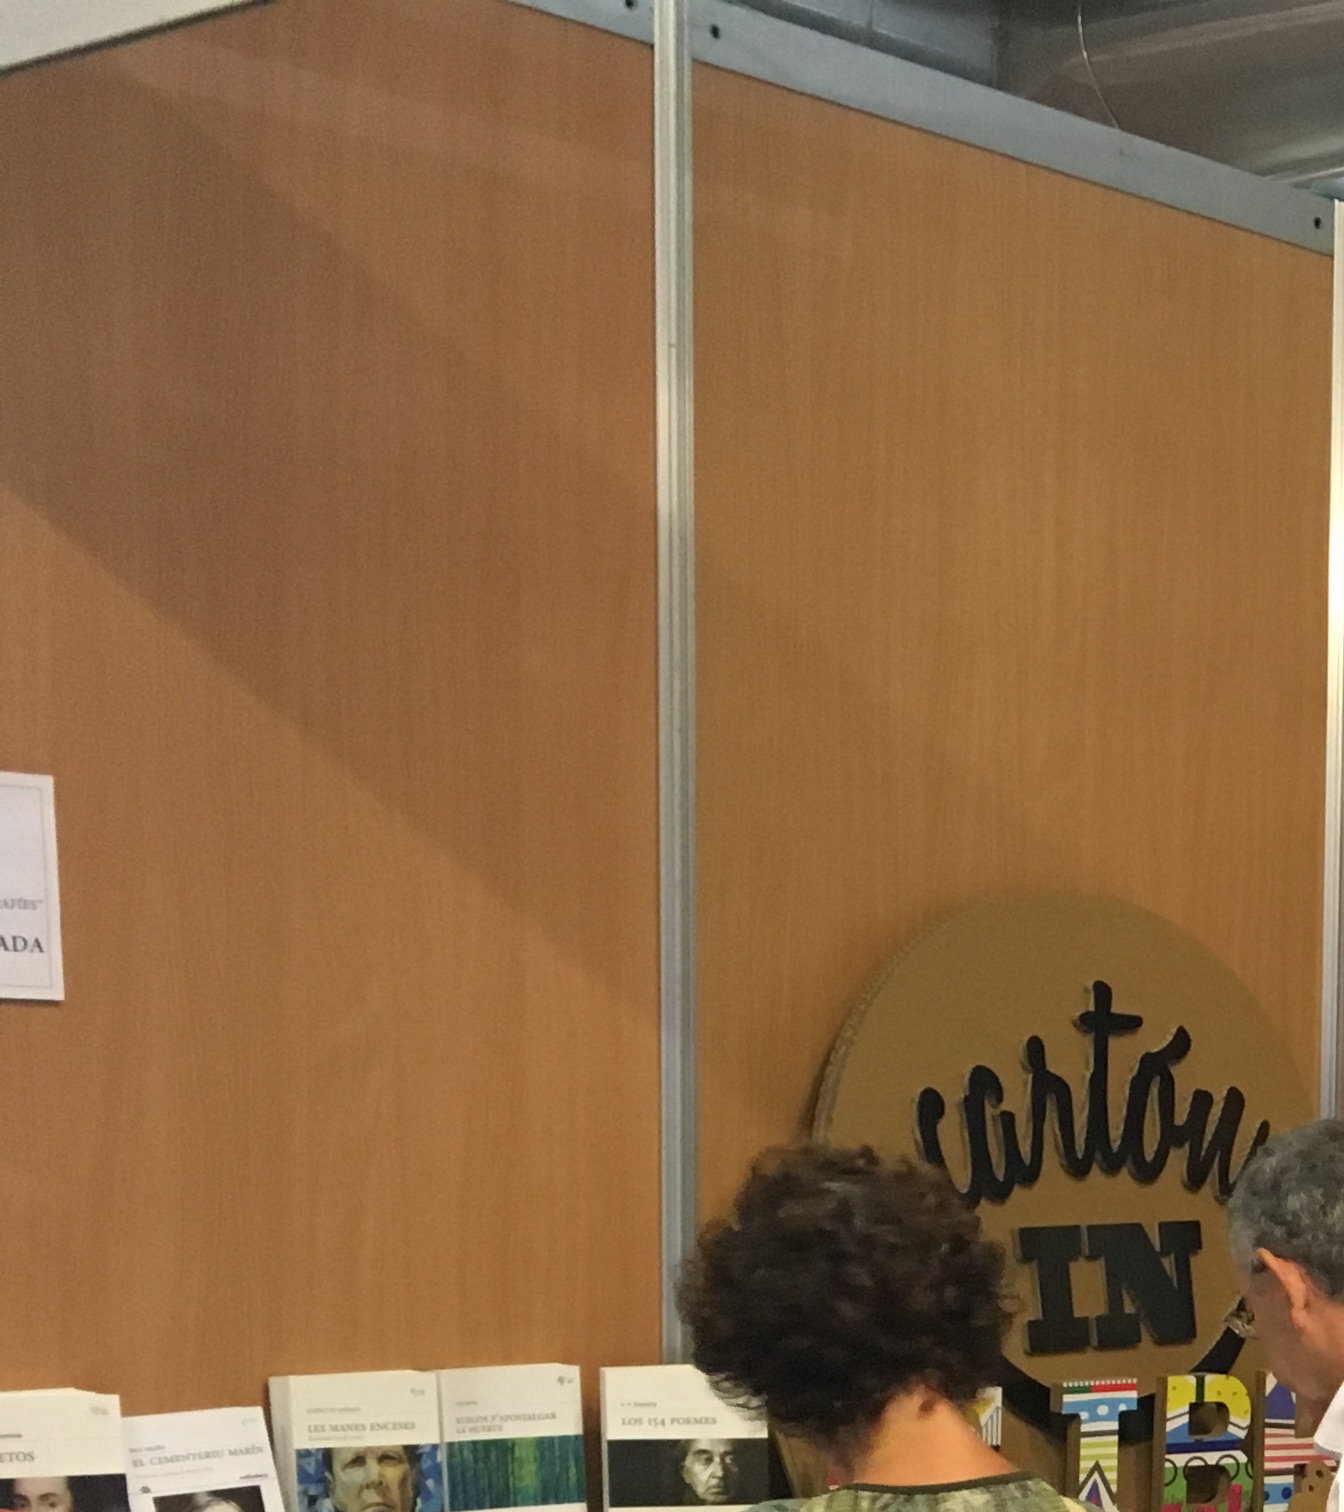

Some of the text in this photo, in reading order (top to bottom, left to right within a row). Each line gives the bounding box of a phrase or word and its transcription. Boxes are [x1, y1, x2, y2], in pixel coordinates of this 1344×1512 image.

[1015, 1219, 1204, 1355] IN
[621, 1416, 643, 1427] LOS
[669, 1415, 718, 1426] POEMES
